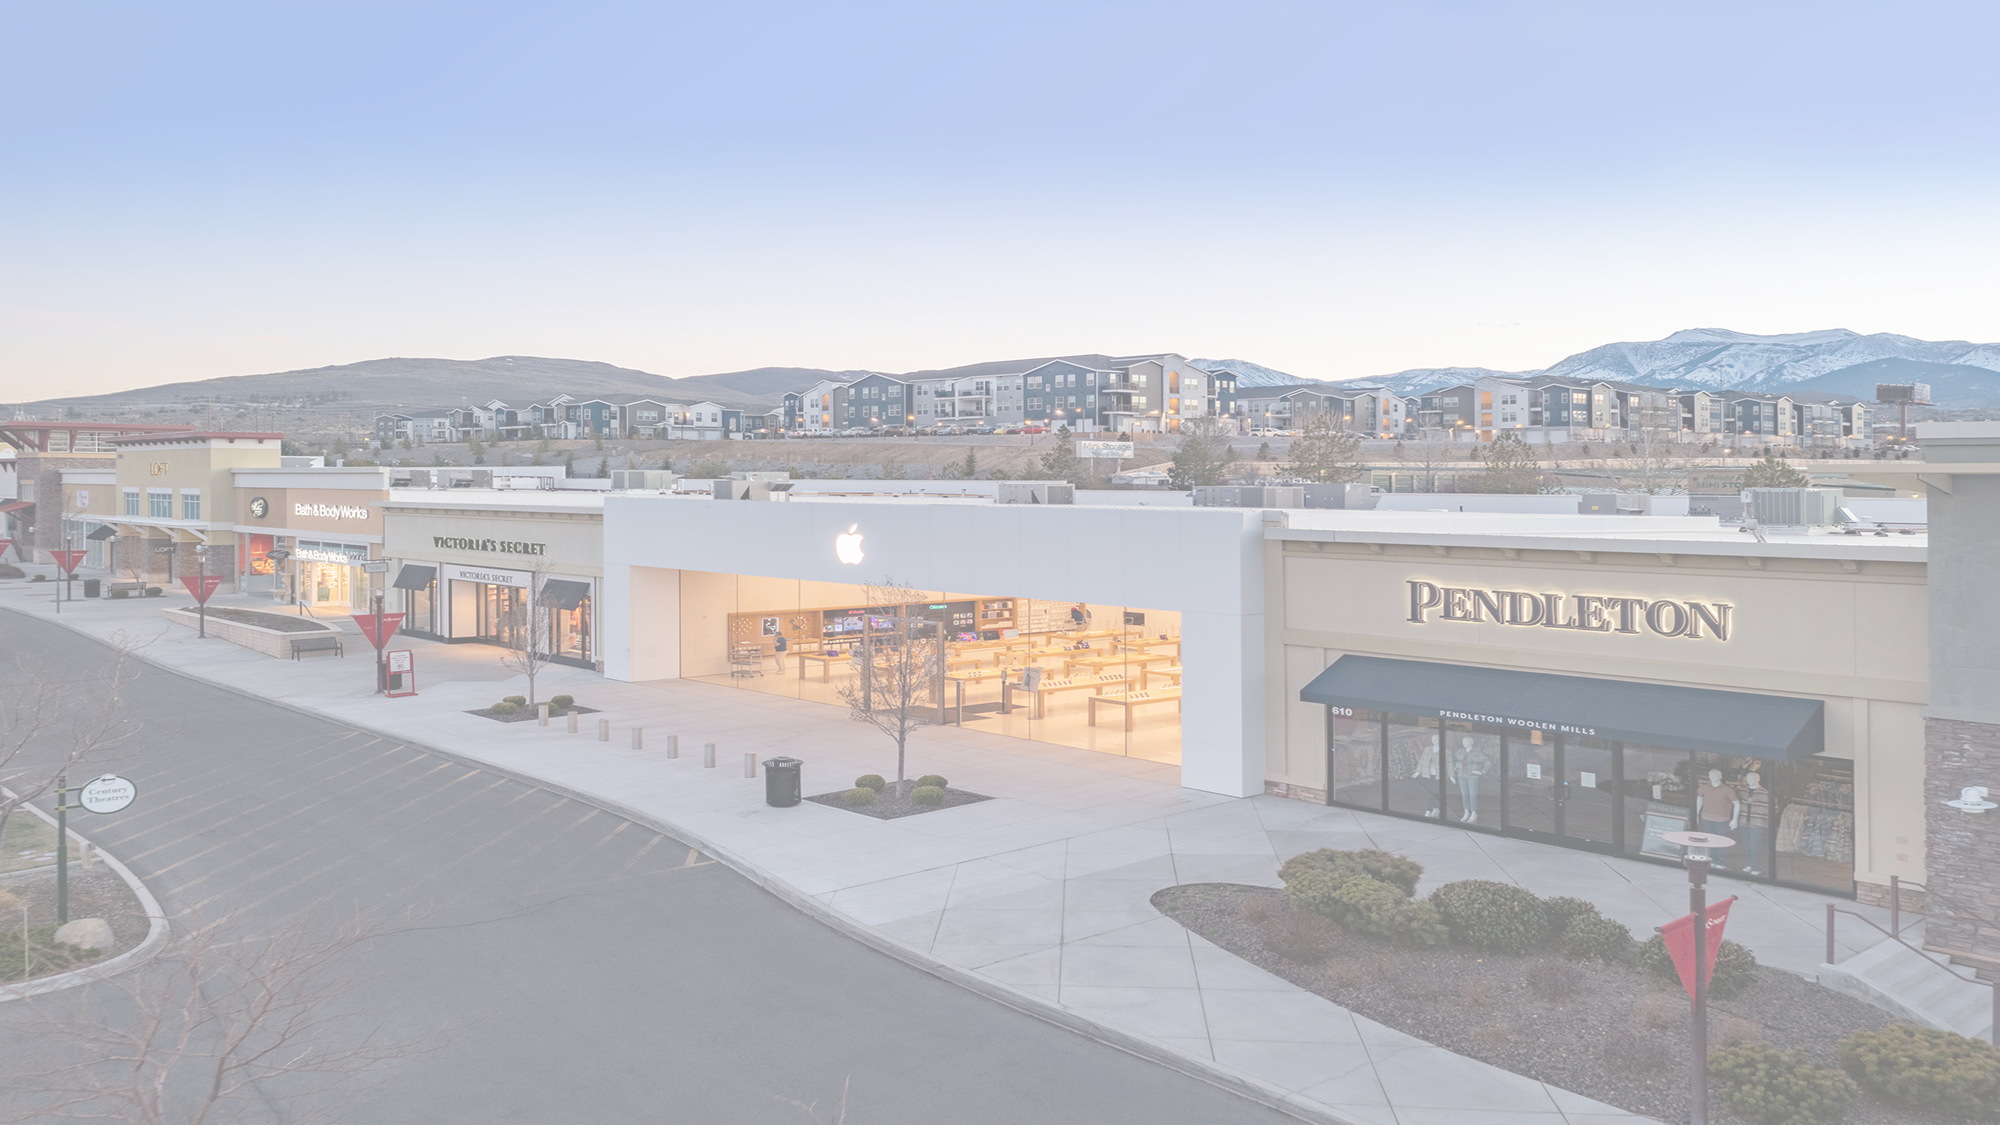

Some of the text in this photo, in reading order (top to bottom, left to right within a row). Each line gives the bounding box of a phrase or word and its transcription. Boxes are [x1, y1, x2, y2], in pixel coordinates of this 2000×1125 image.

[1101, 443, 1131, 452] Storage
[149, 462, 170, 476] LOFT
[295, 503, 368, 520] Bath & Body Works
[433, 536, 547, 556] VICTORIA'S SECRET
[459, 571, 513, 583] VICTORIA'S SECRET
[1406, 579, 1733, 642] PENDLETON
[1331, 706, 1353, 717] 610
[1439, 709, 1596, 737] PENDLETON WOOLEN MILLS
[88, 787, 129, 795] Century
[86, 795, 130, 803] Theatres
